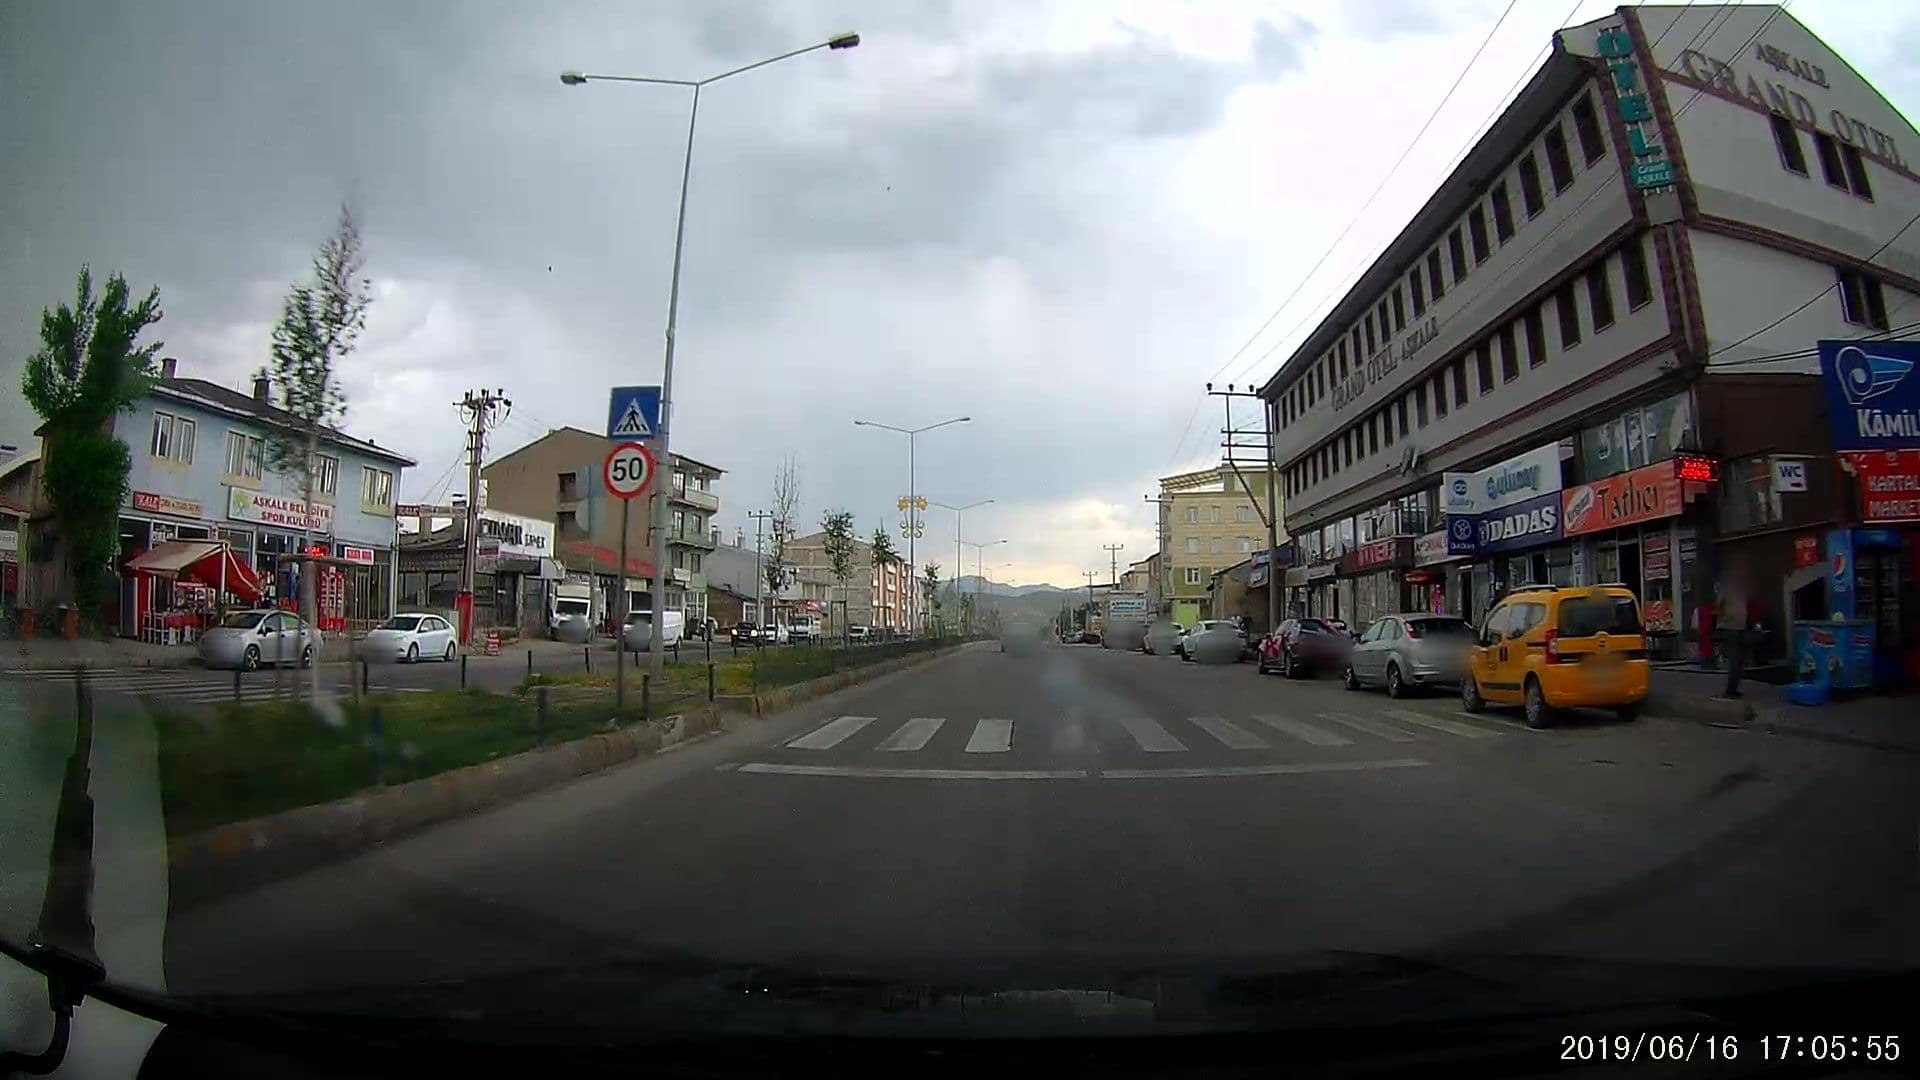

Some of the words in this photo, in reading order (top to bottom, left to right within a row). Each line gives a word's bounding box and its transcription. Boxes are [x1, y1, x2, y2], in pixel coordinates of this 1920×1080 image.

[1597, 29, 1663, 158] OTEL
[1682, 48, 1816, 129] GRAND
[1830, 108, 1909, 171] OTEL
[612, 457, 643, 481] 50
[1779, 465, 1802, 478] WC
[261, 511, 285, 524] SPOR
[1490, 506, 1557, 541] DADAŞ
